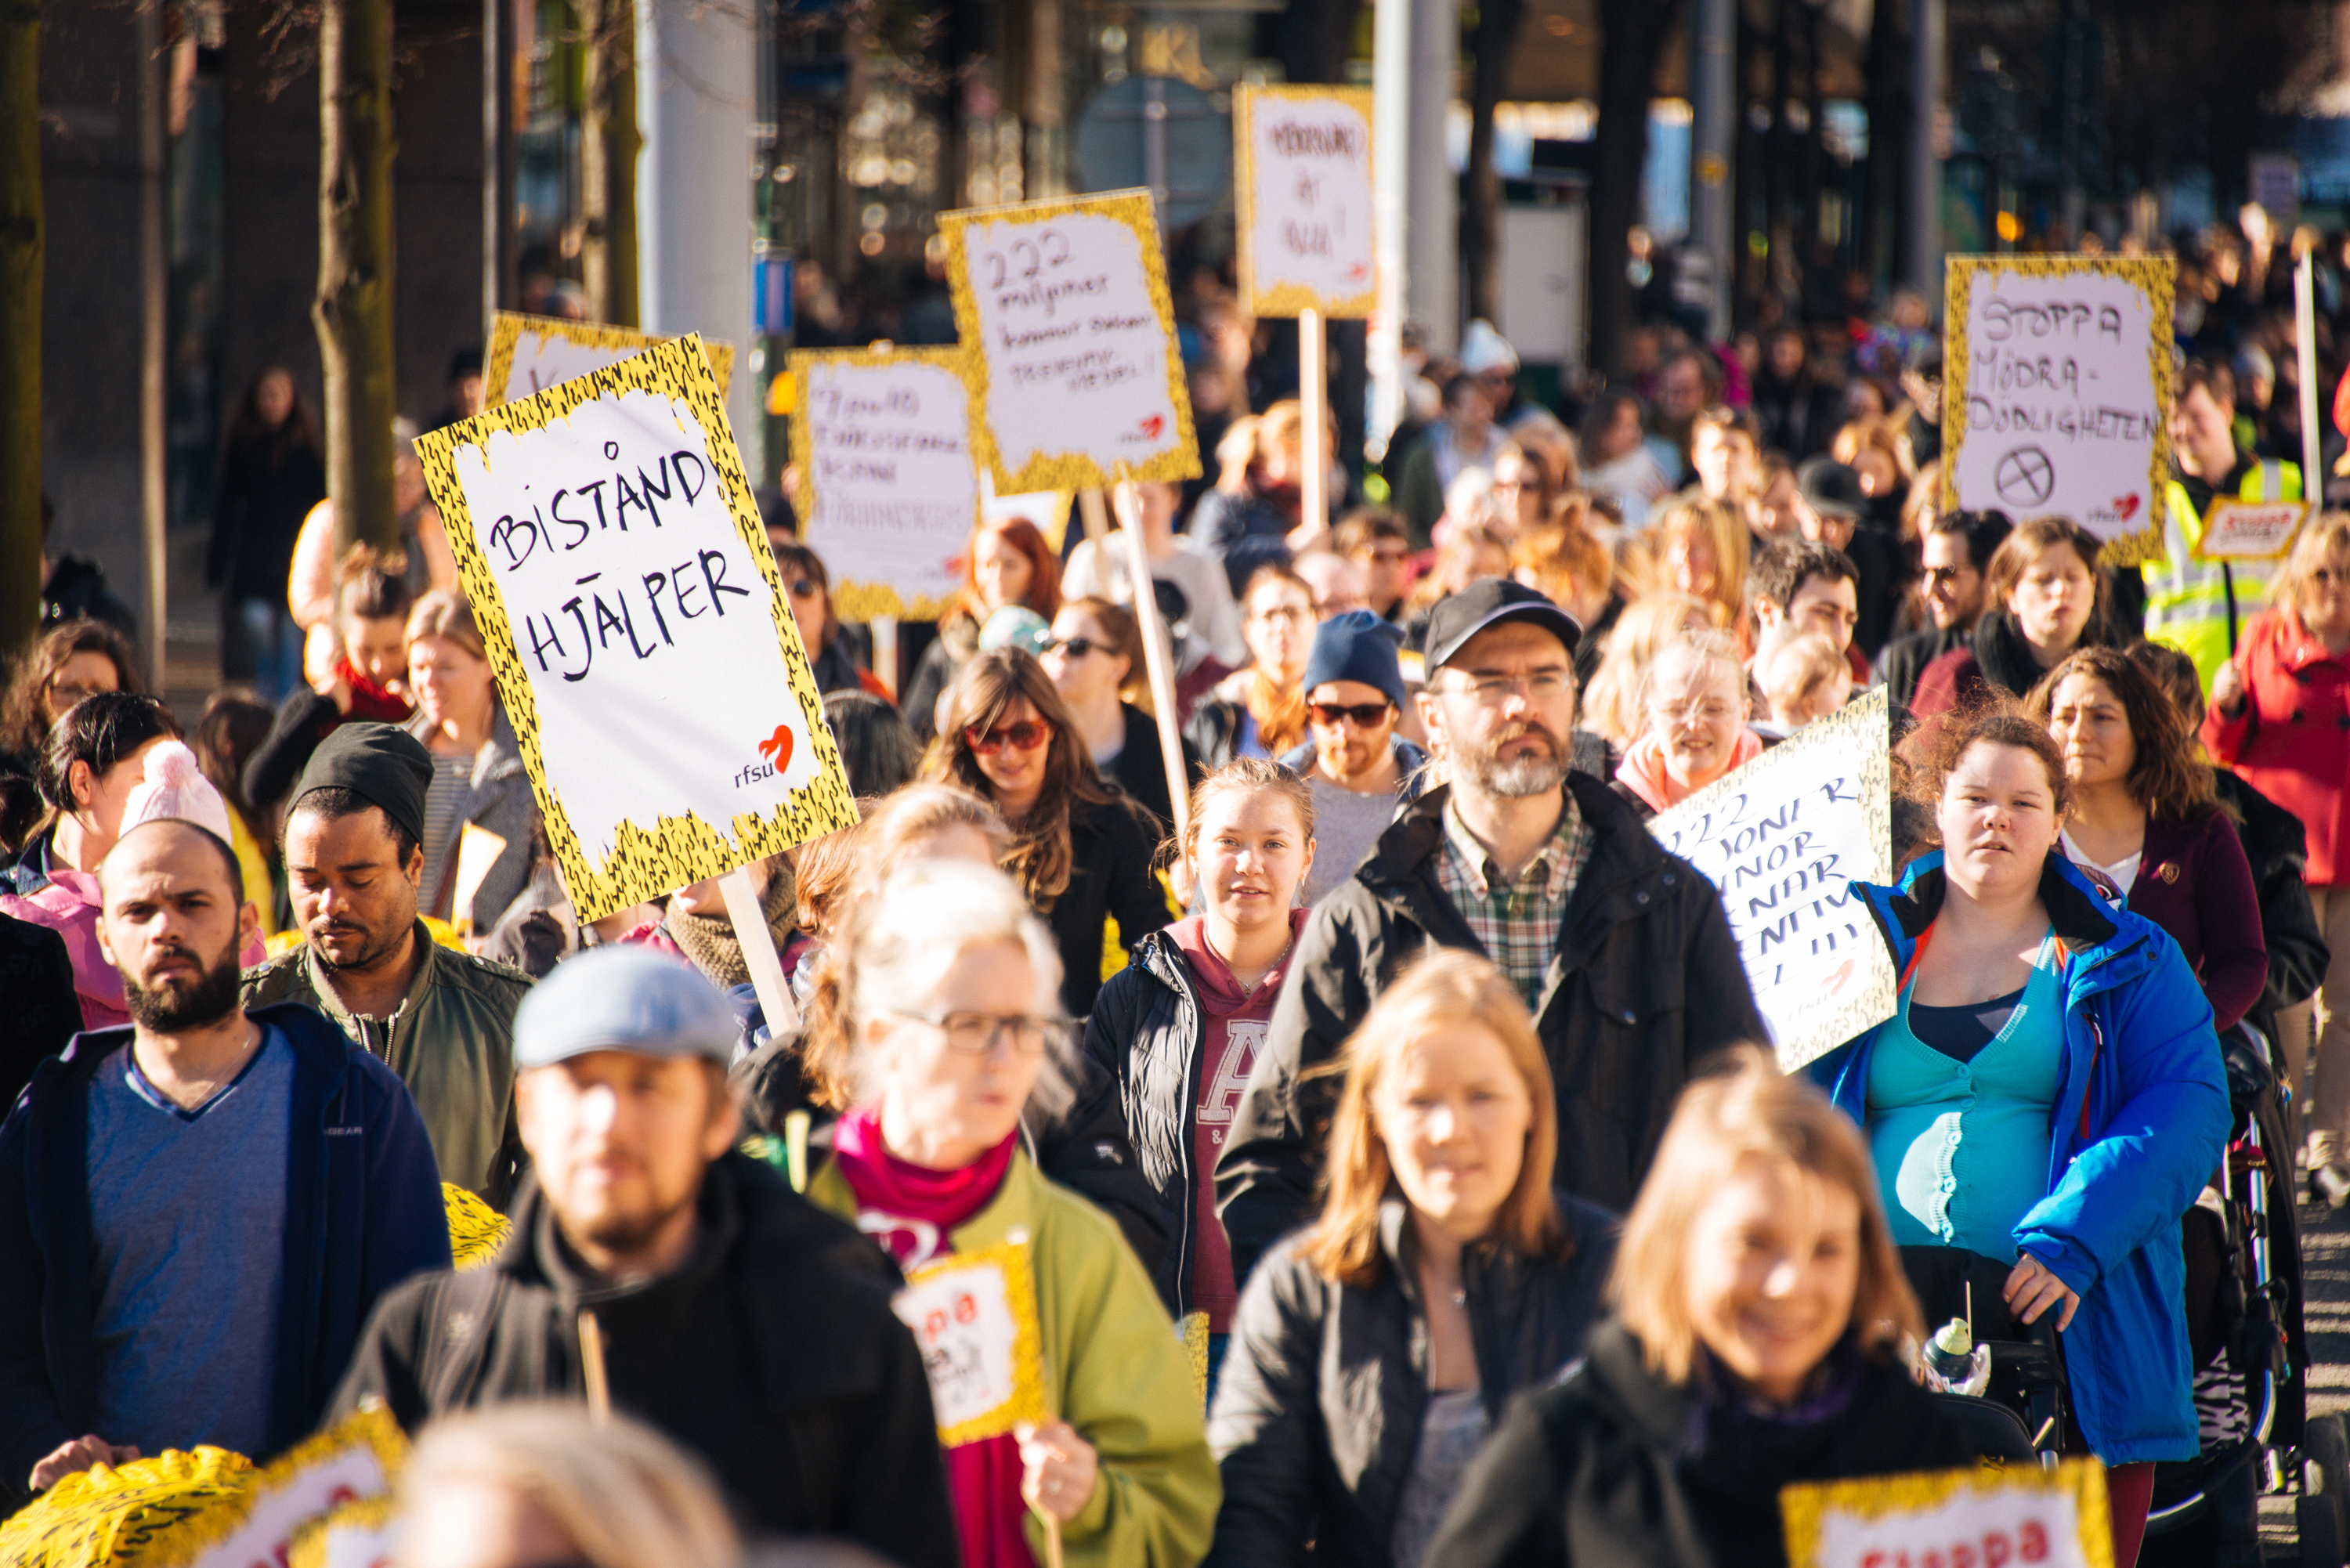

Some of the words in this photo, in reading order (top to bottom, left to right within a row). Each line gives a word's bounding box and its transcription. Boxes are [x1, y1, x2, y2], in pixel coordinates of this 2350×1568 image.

[984, 227, 1074, 290] 222
[997, 273, 1109, 316] miljoner
[1983, 295, 2122, 345] STOPPA
[1974, 347, 2099, 398] MÖDRA-
[1967, 394, 2160, 444] DÖDLIGHETEN
[526, 549, 750, 681] HJÄLPER
[734, 760, 775, 789] rfsu
[1688, 778, 1864, 865] JONER
[1730, 854, 1847, 927] NAR
[323, 1126, 363, 1135] GEAR
[1212, 1129, 1224, 1144] &
